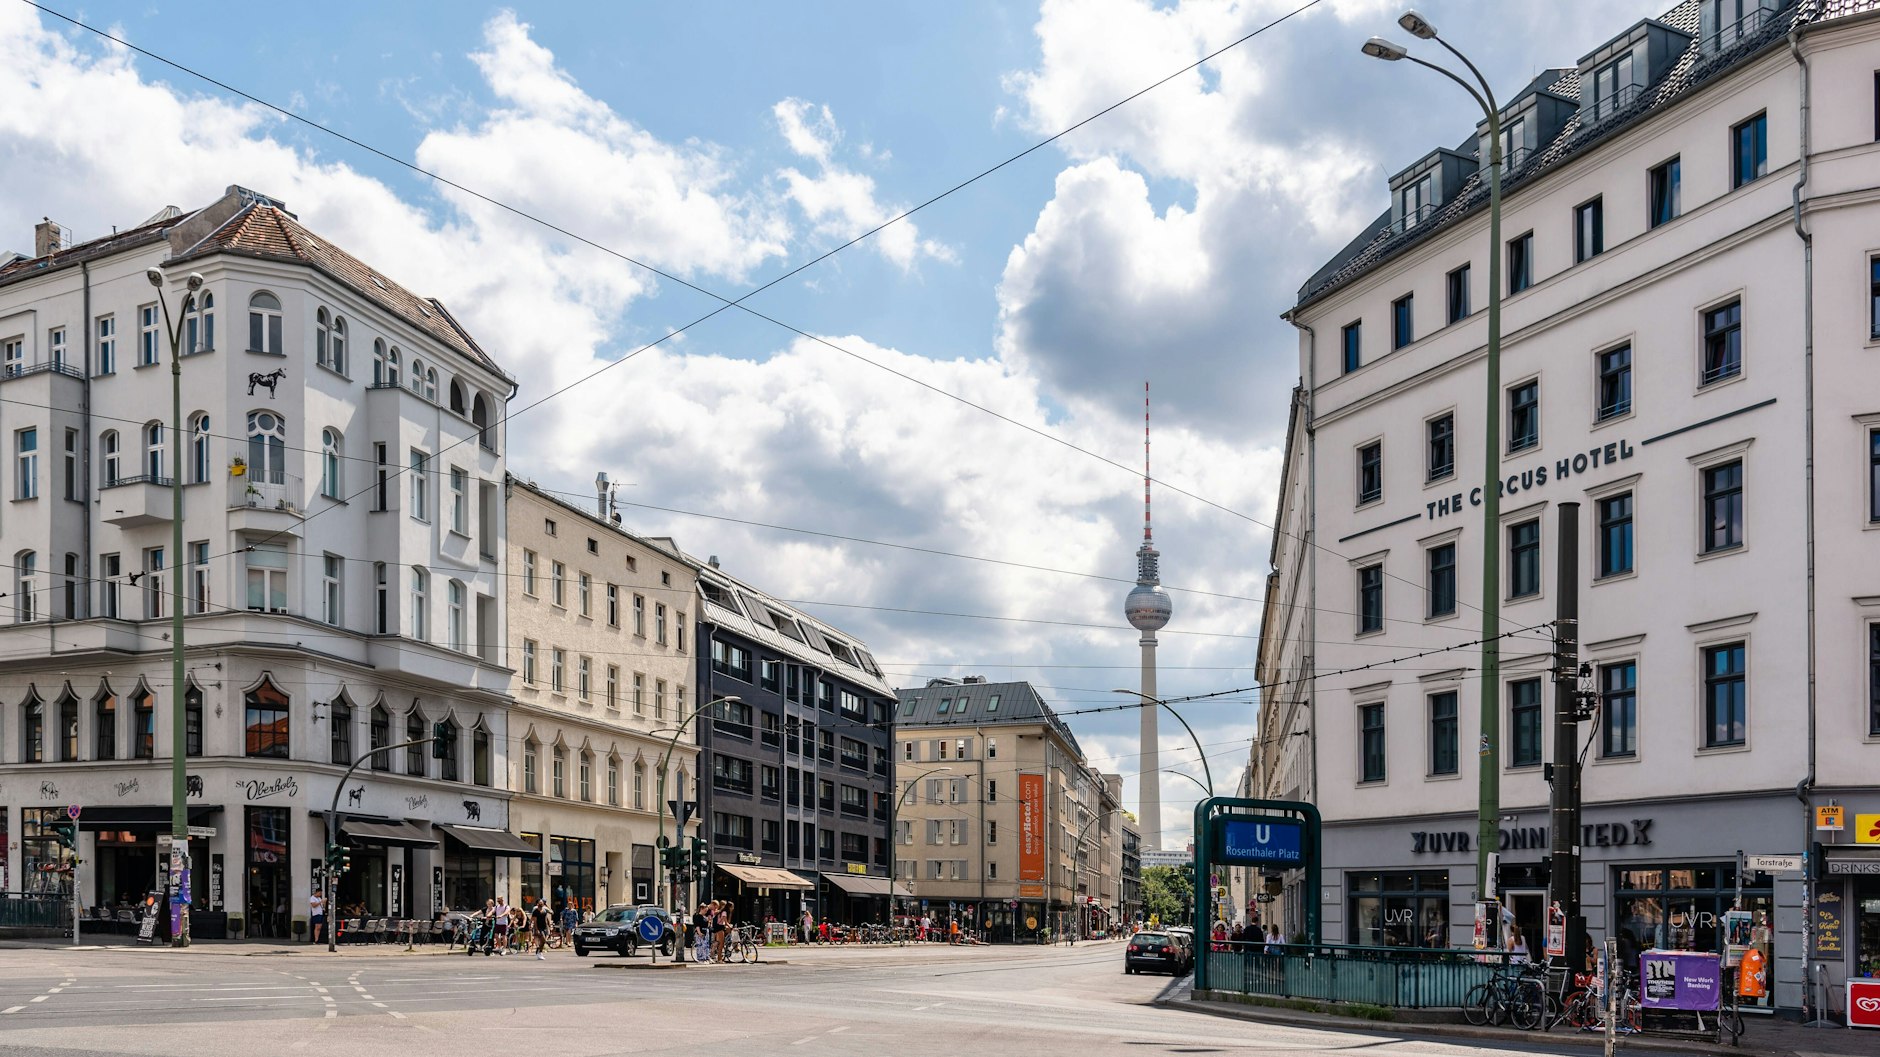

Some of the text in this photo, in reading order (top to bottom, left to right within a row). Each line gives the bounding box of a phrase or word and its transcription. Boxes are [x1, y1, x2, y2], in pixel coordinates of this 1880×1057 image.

[1426, 439, 1634, 520] THE CCUS HOTEL
[235, 776, 299, 801] St Oberholz
[1825, 817, 1835, 826] EC
[1256, 824, 1271, 845] U
[1428, 831, 1470, 853] UVR
[1226, 845, 1300, 860] Rosenthaler Platz
[1756, 858, 1793, 868] Torstraße
[1831, 863, 1880, 873] DRINKS
[1384, 908, 1413, 923] UVR
[1670, 911, 1713, 929] UVR
[1687, 982, 1711, 990] Banking
[1698, 976, 1714, 984] Work
